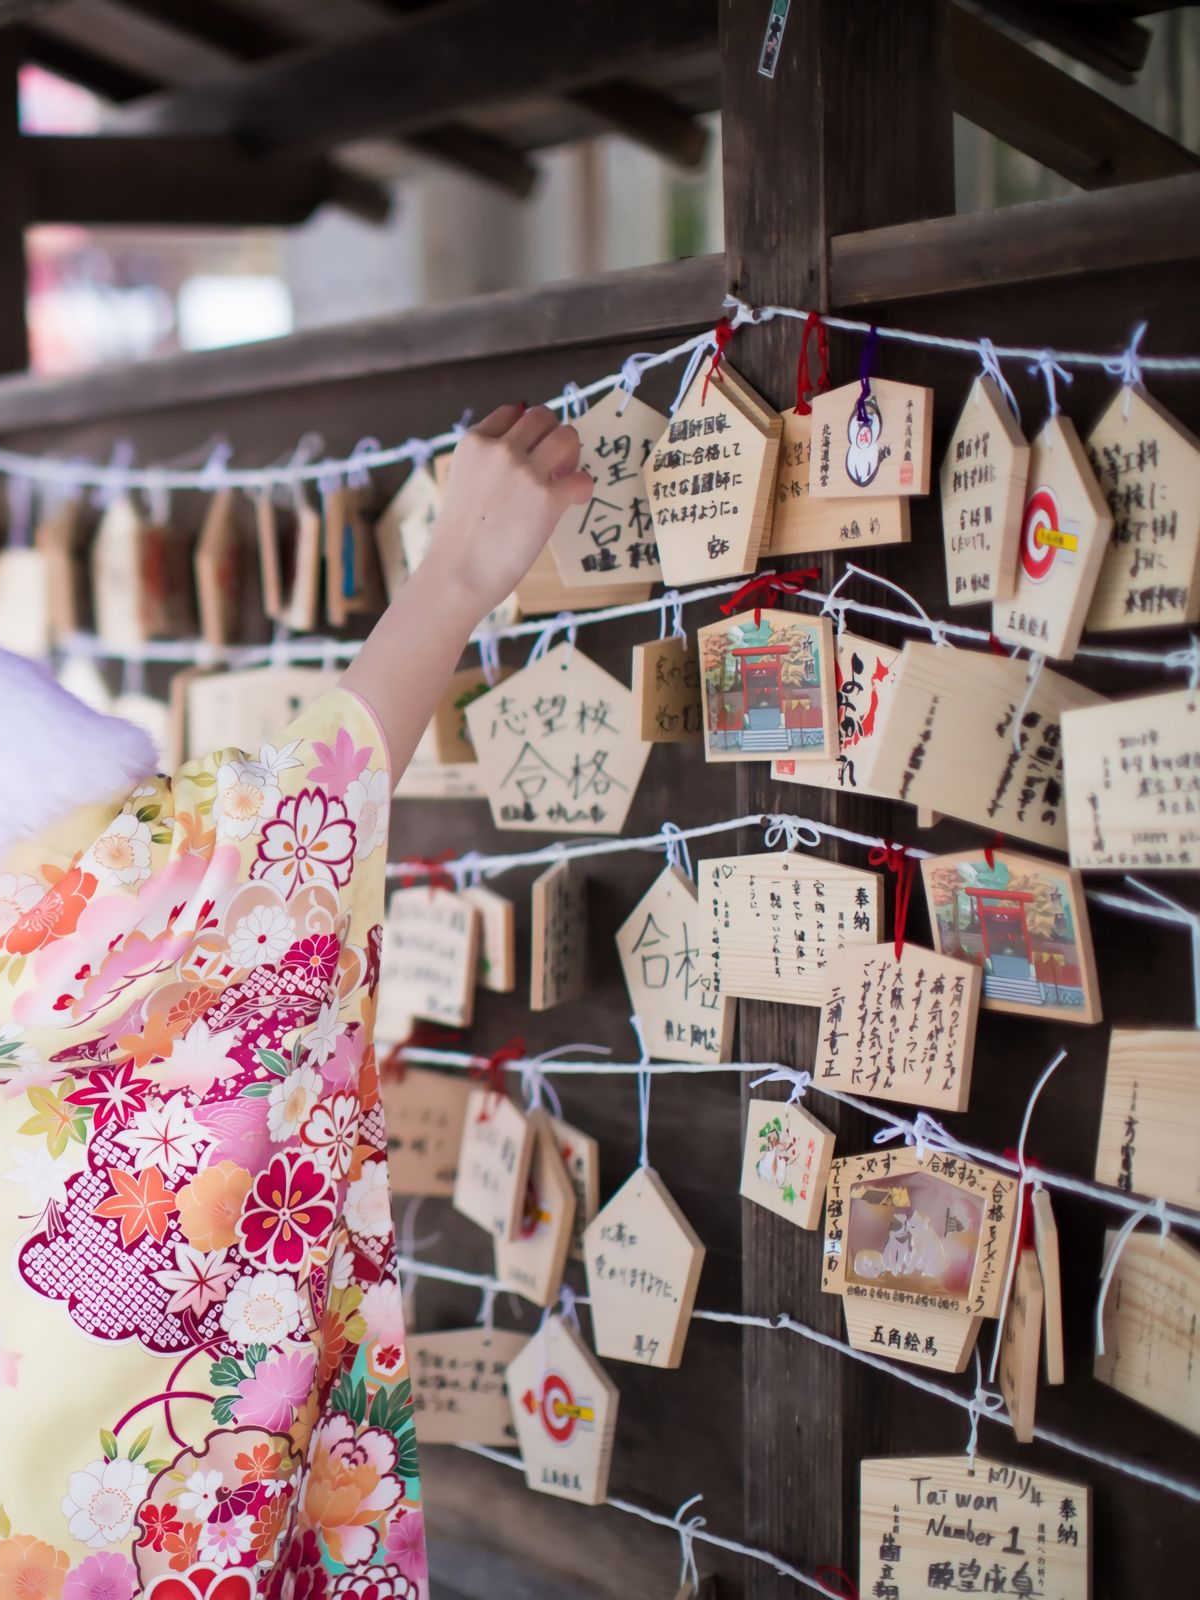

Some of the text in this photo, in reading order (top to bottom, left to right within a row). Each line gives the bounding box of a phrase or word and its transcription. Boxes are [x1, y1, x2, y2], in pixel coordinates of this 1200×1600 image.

[491, 694, 620, 739] 志望校
[499, 741, 630, 801] 合格
[853, 886, 870, 933] 奉納
[903, 968, 927, 1074] ますように
[870, 1325, 938, 1357] 五角絵馬
[910, 1475, 998, 1513] Taiwan
[926, 1514, 1026, 1555] Number 1
[1057, 1496, 1078, 1547] 奉納
